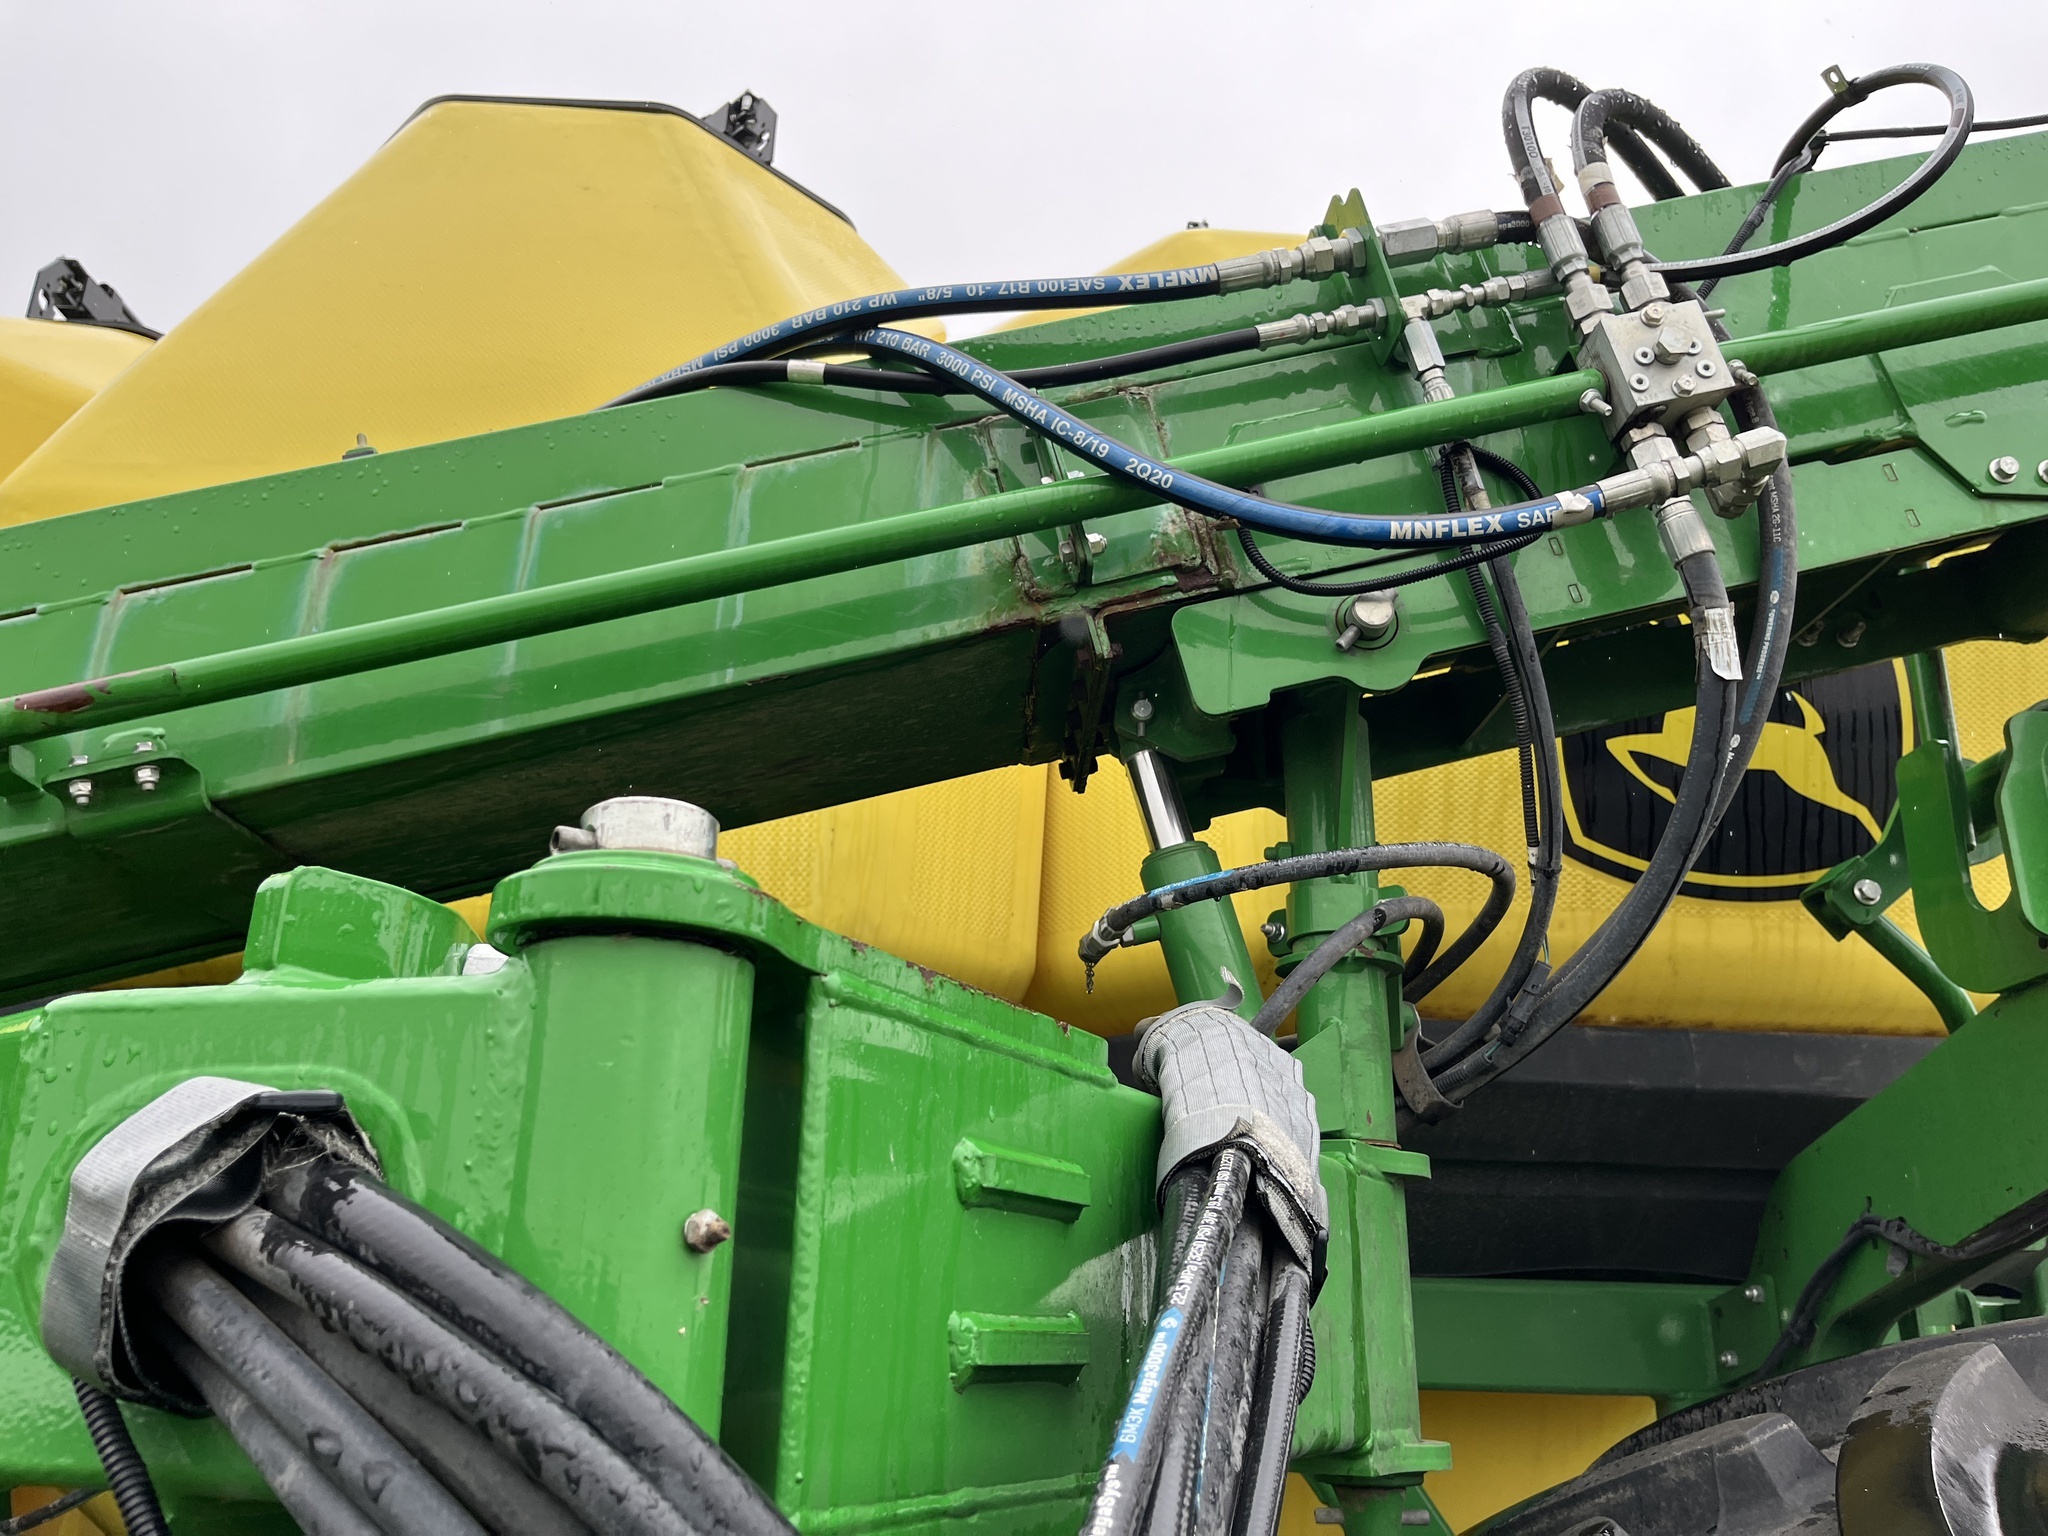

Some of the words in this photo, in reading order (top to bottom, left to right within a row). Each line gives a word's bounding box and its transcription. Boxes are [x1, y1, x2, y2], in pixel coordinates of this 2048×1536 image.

[1521, 125, 1539, 158] T3010D
[998, 281, 1031, 296] R17
[1037, 276, 1106, 294] SAE100
[1118, 266, 1218, 292] MNFLEX
[868, 292, 898, 309] WP
[918, 286, 953, 302] 5/8"
[966, 284, 992, 297] -10
[791, 310, 828, 329] BAR
[832, 302, 862, 317] 210
[743, 323, 780, 347] 3000
[713, 340, 739, 362] PSI
[876, 331, 900, 347] 210
[901, 337, 932, 358] BAR
[936, 351, 971, 376] 3000
[970, 368, 998, 392] PSI
[1001, 387, 1050, 425] MSHA
[1049, 416, 1110, 458] IC-8/19
[1124, 457, 1174, 489] 2Q20
[1389, 513, 1505, 541] MNFLEX
[1170, 1282, 1192, 1305] 22.5
